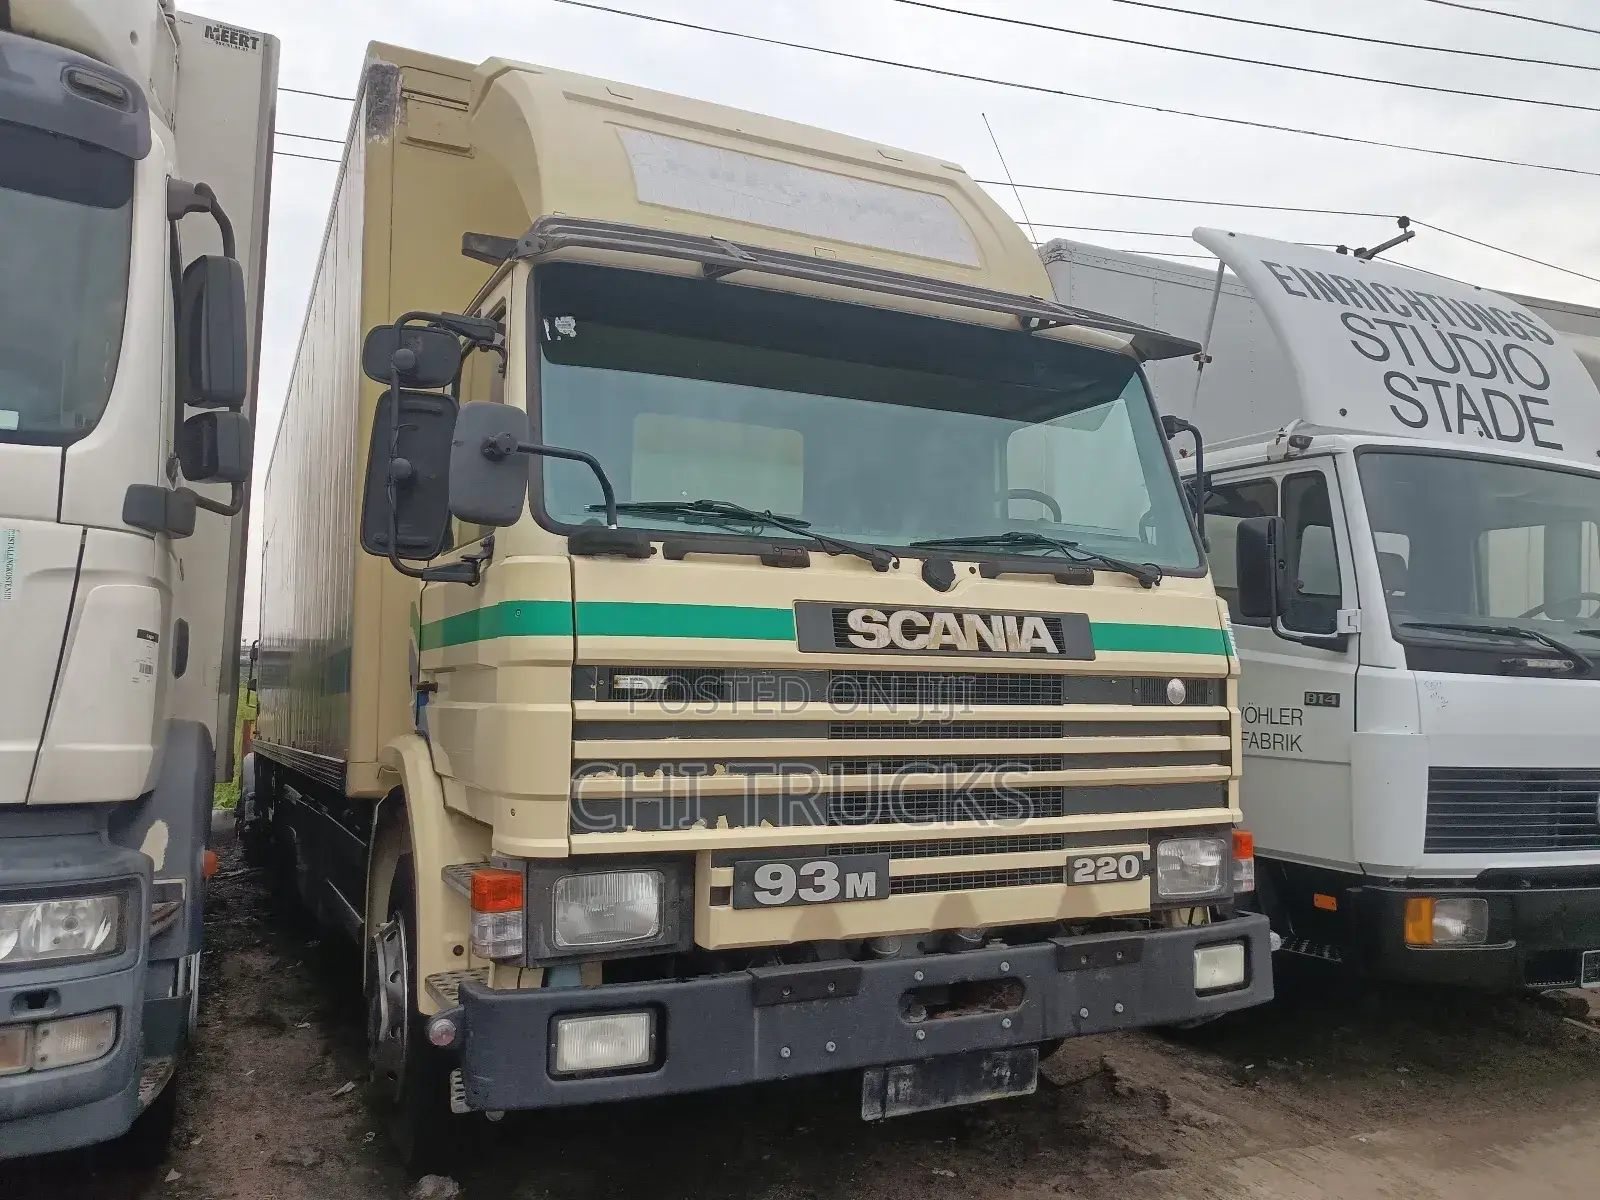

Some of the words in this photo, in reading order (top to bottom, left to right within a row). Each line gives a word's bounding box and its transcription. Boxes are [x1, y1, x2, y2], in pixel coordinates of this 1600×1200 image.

[204, 25, 260, 50] MEERT
[1260, 259, 1555, 346] EINRICHTUNGS
[1383, 370, 1564, 452] STADE
[846, 608, 1060, 654] SCANIA
[1305, 692, 1338, 706] 814
[1073, 854, 1140, 883] 220
